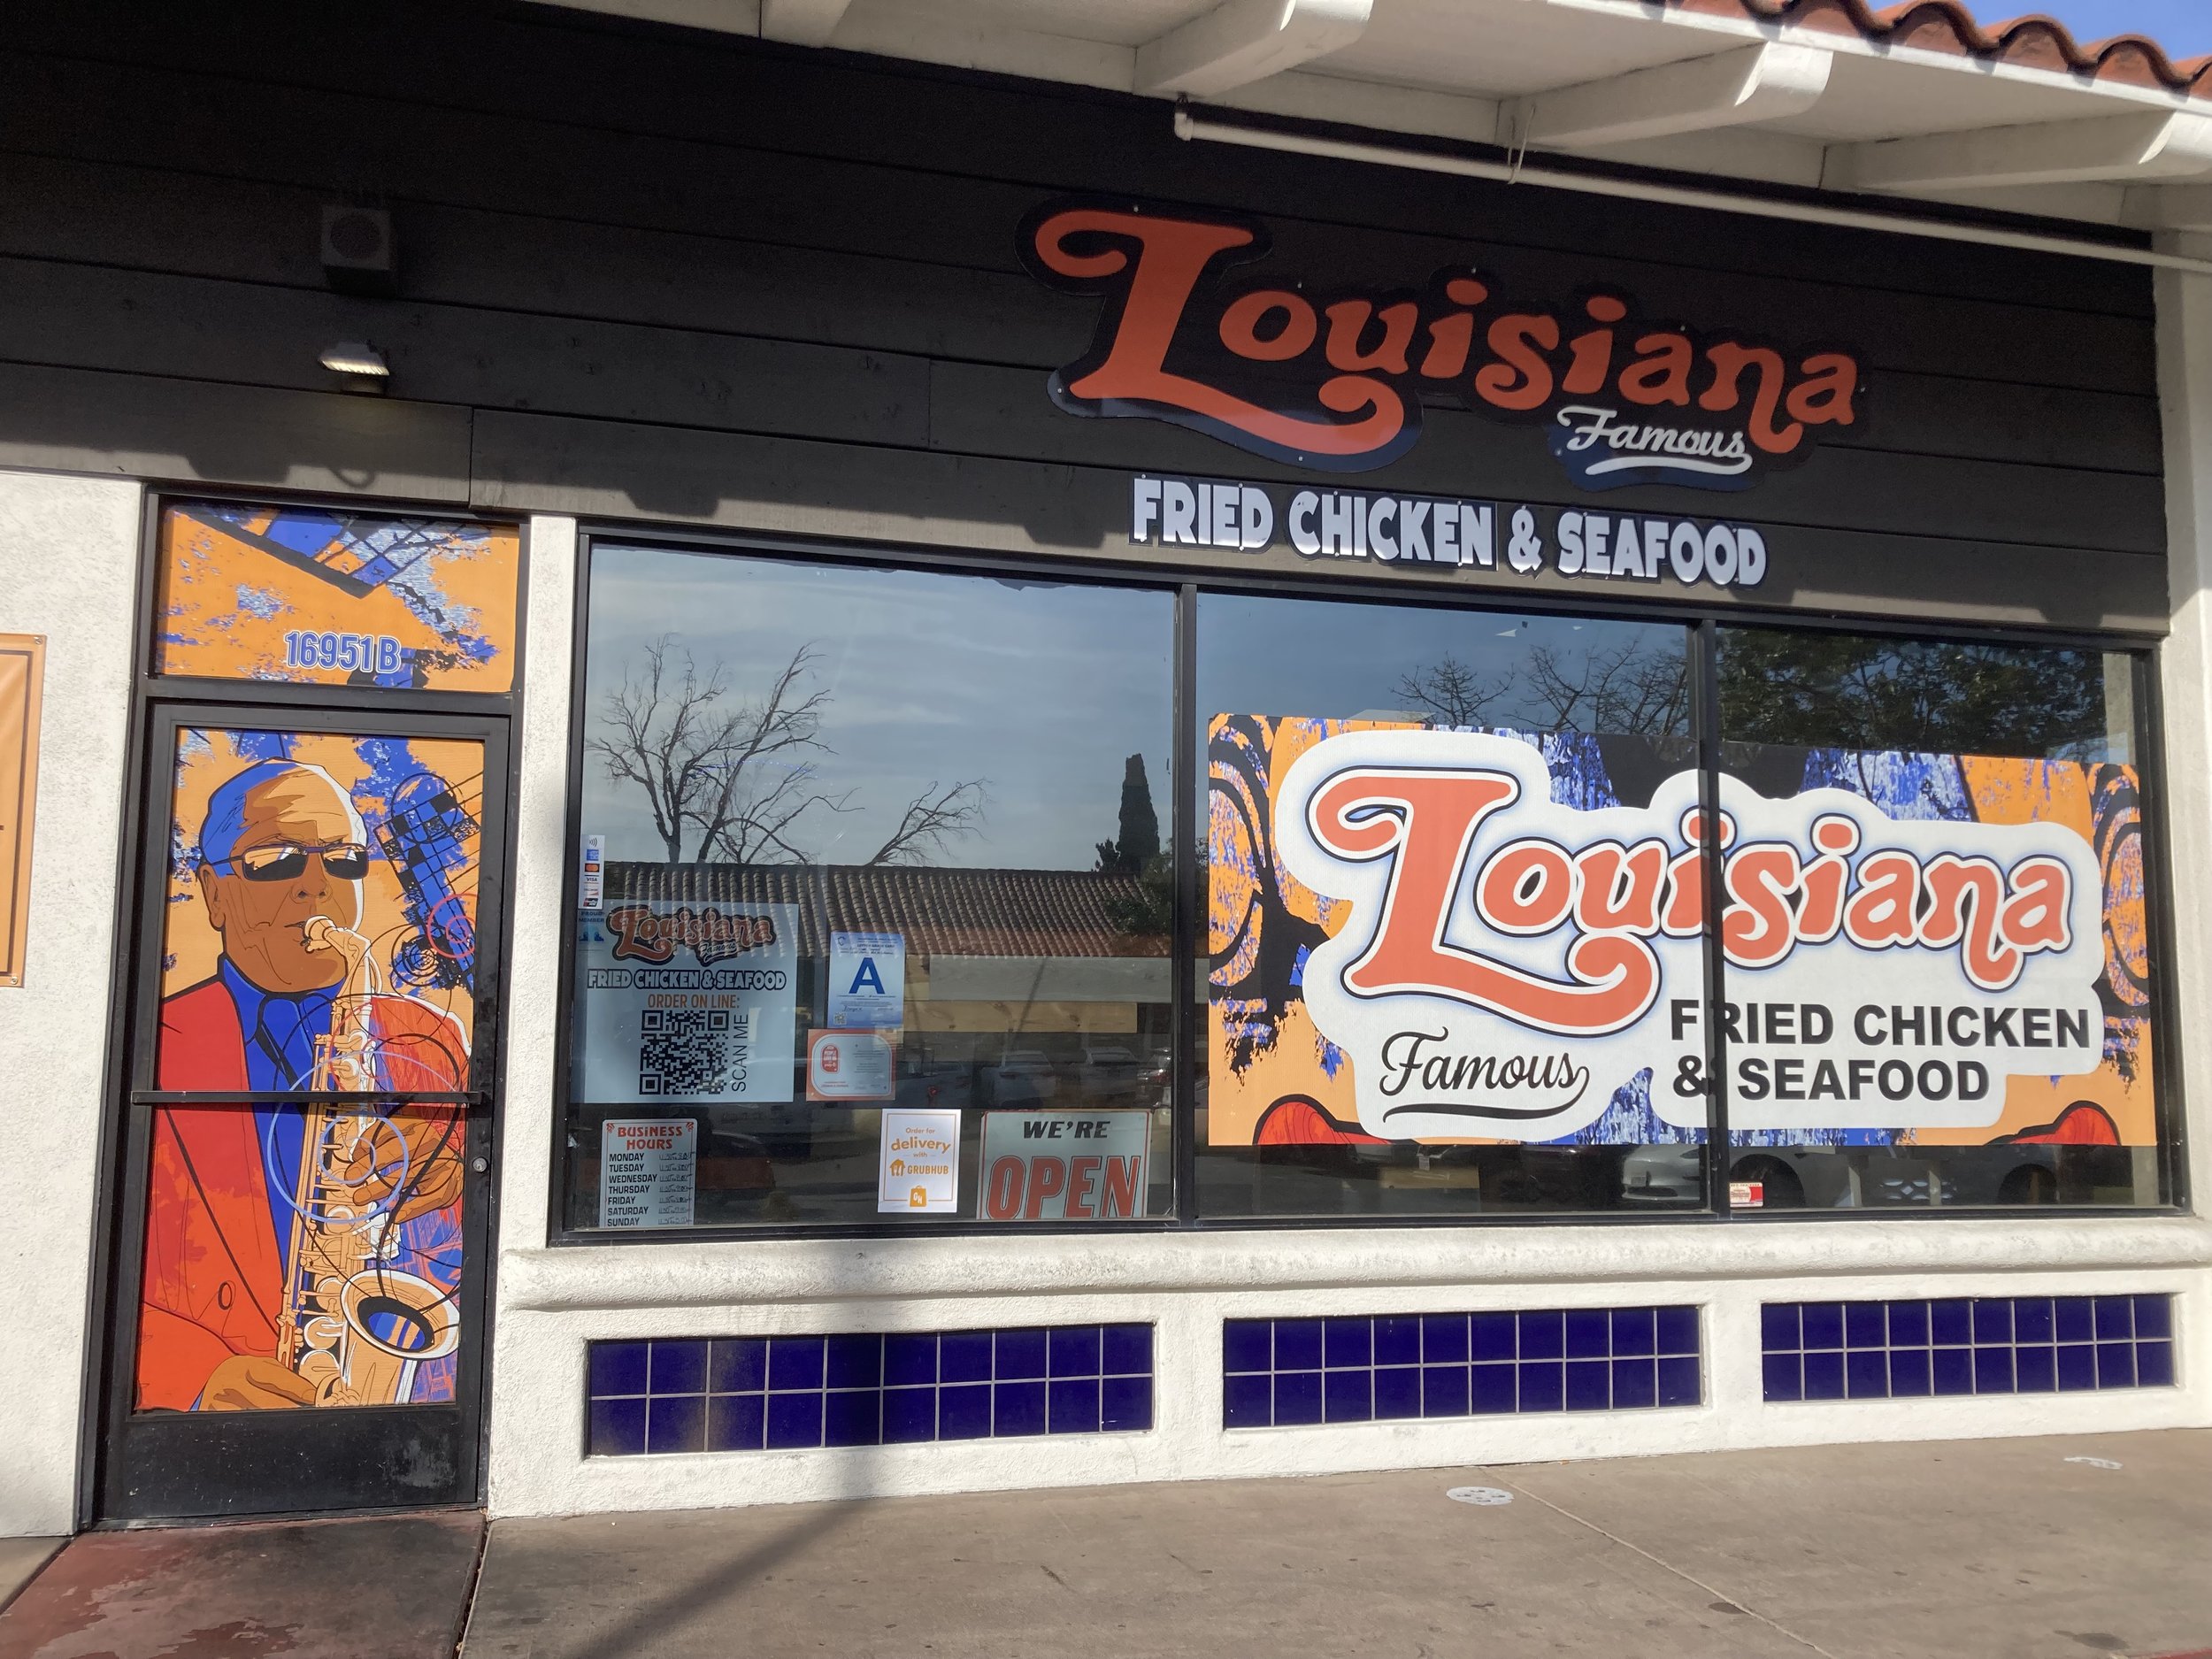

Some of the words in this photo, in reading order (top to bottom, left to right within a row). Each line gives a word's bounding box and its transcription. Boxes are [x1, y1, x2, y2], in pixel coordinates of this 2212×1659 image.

[1034, 209, 1857, 454] Louisiana
[1557, 404, 1753, 475] Famous
[1133, 476, 1273, 550] FRIED
[1287, 489, 1497, 568] CHICKEN
[1508, 506, 1543, 574] &
[1558, 511, 1768, 587] SEAFOOD
[1310, 765, 2073, 1036] Louisiana
[608, 907, 774, 962] Louisiana
[588, 969, 632, 989] FRIED
[634, 969, 701, 990] CHICKEN
[701, 971, 718, 990] &
[715, 970, 787, 990] SEAFOOD
[849, 957, 886, 994] A
[648, 994, 687, 1008] ORDER
[691, 995, 707, 1009] ON
[711, 995, 740, 1010] LINE:
[733, 1014, 749, 1040] ME
[1671, 998, 1832, 1047] FRIED
[1853, 1003, 2090, 1049] CHICKEN
[732, 1045, 747, 1093] SCAN
[1380, 1025, 1591, 1106] Famous
[1671, 1055, 1713, 1100] &
[1737, 1057, 1990, 1102] SEAFOOD
[1023, 1120, 1110, 1139] WE'RE
[626, 1139, 673, 1150] HOURS
[891, 1136, 951, 1154] delivery
[609, 1153, 644, 1162] MONDAY
[609, 1164, 644, 1172] TUESDAY
[609, 1174, 657, 1183] WEDNESDAY
[907, 1165, 949, 1175] GRUBHUB
[609, 1185, 650, 1194] THURSDAY
[985, 1155, 1141, 1219] OPEN
[607, 1196, 636, 1205] FRIDAY
[607, 1206, 649, 1216] SATURDAY
[607, 1217, 640, 1227] SUNDAY
